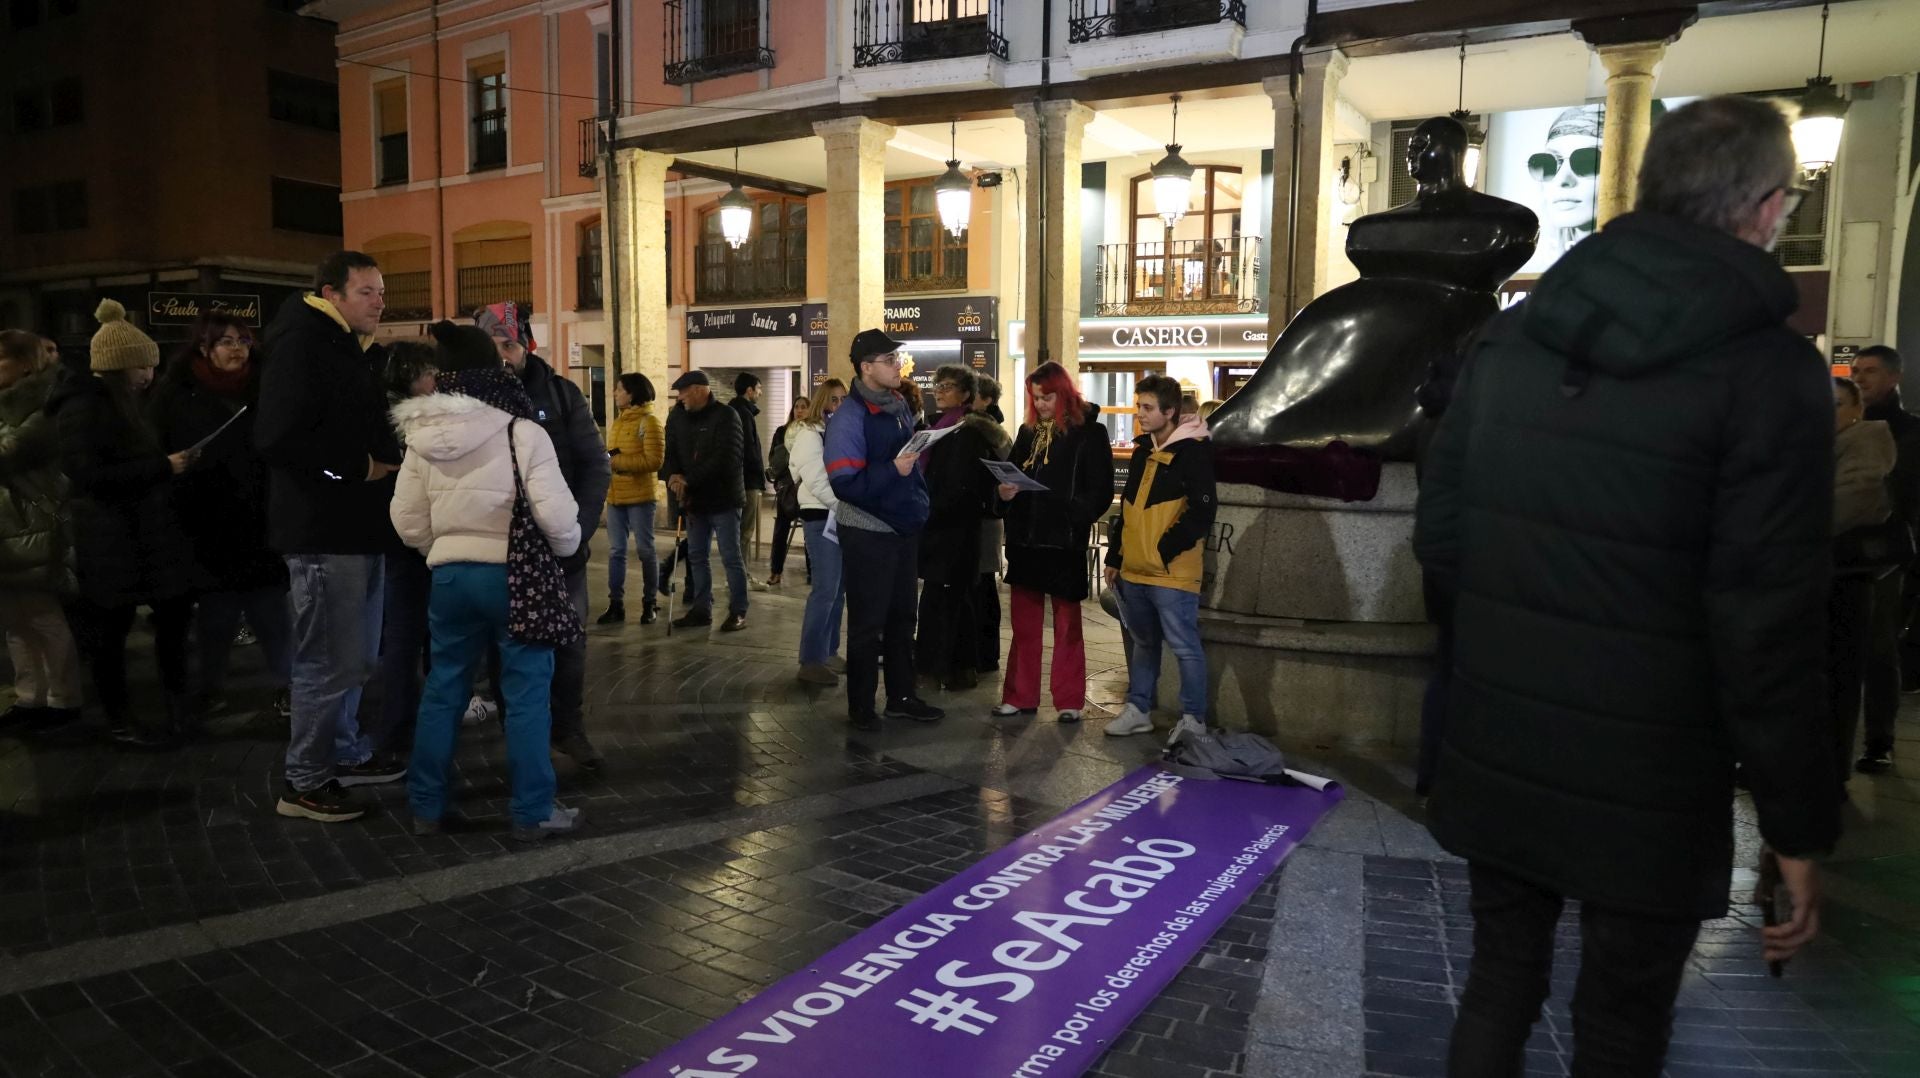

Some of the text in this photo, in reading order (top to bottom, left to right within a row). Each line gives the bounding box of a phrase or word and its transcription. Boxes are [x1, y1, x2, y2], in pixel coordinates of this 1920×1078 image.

[152, 297, 200, 316] Paula
[750, 312, 778, 331] Sandra
[890, 322, 914, 332] PLATA
[958, 316, 980, 325] ORO
[1243, 824, 1290, 854] Palencia
[1233, 853, 1258, 865] de
[1198, 864, 1247, 901] mujeres
[736, 913, 972, 1044] VIOLENCIA
[953, 844, 1077, 910] CONTRA
[1055, 818, 1112, 846] LAS
[1095, 770, 1184, 821] MUJERES
[1176, 900, 1210, 917] las
[1163, 916, 1194, 932] de
[895, 836, 1197, 1036] #SeAcabó
[1105, 931, 1179, 989] derechos
[1075, 989, 1119, 1012] los
[1052, 1011, 1095, 1044] por
